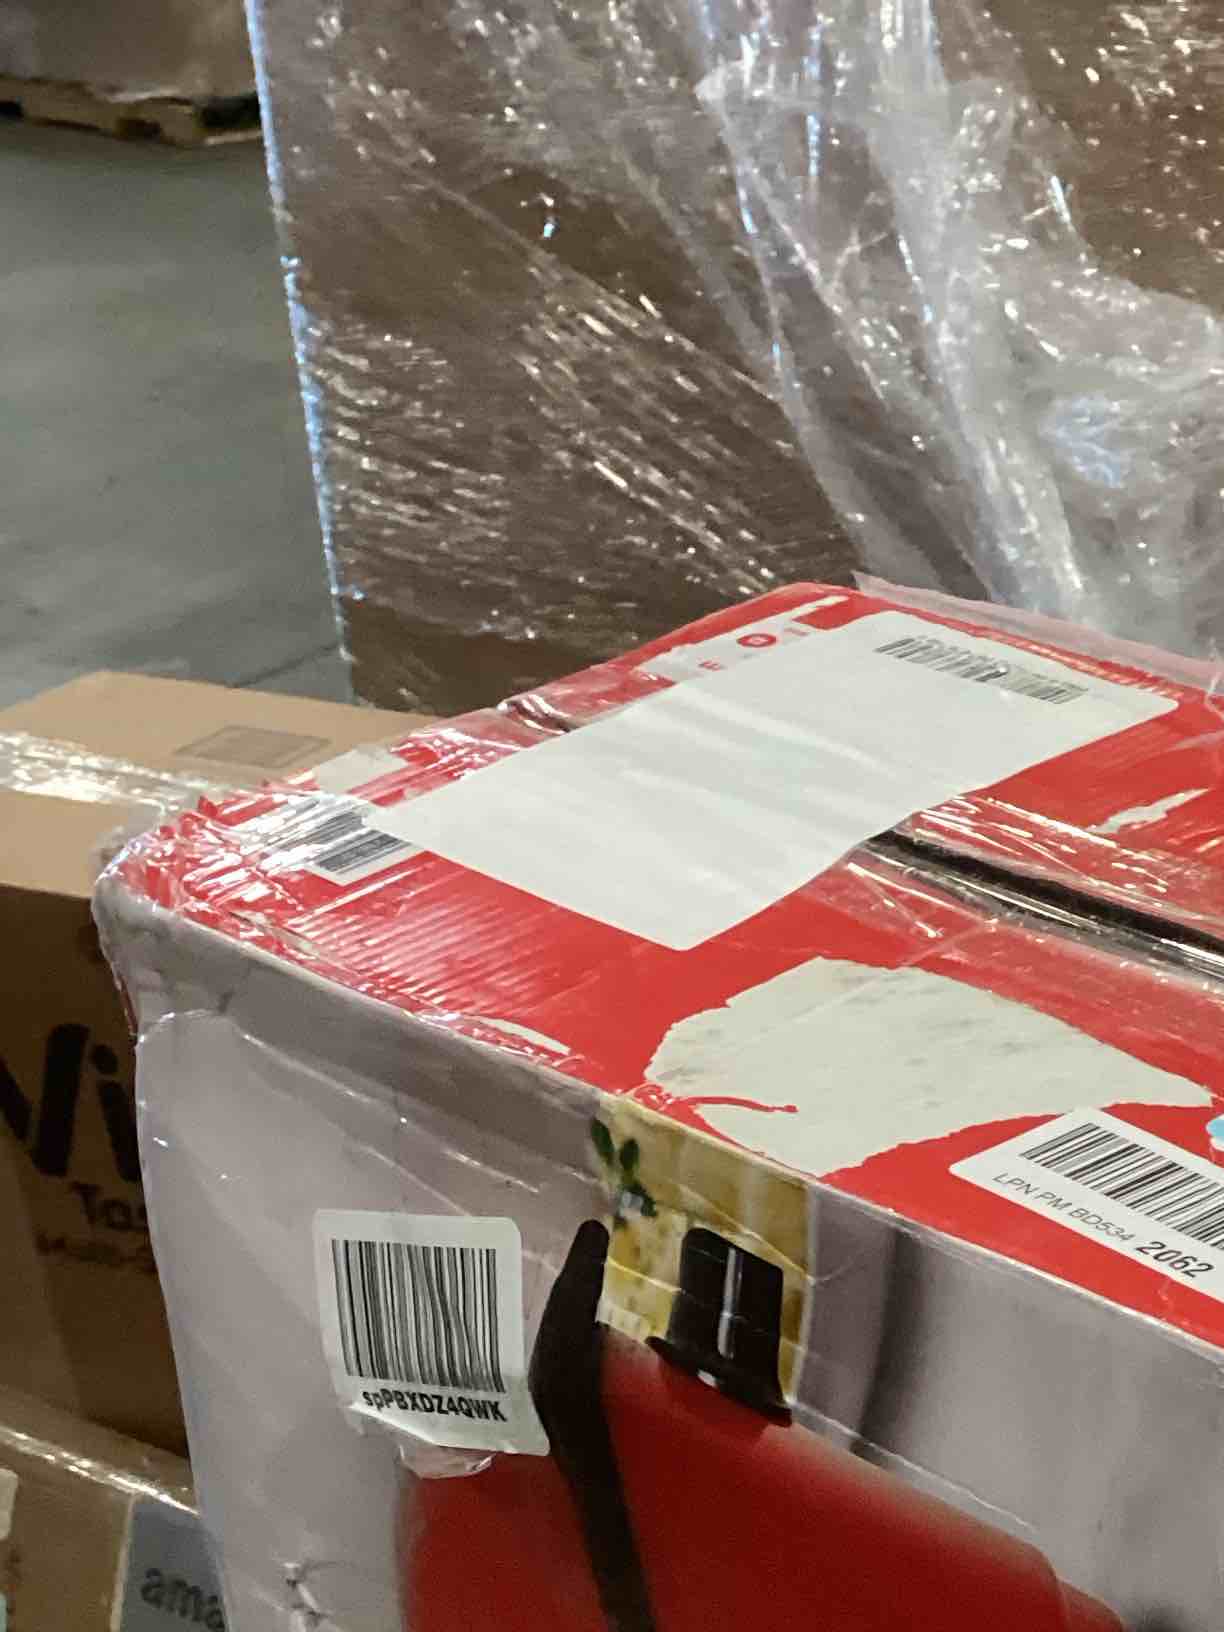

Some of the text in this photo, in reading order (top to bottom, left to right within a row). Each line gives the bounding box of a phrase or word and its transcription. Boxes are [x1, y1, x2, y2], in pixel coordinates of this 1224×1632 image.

[992, 1173, 1035, 1197] LPN
[1035, 1190, 1074, 1213] PM
[1136, 1240, 1215, 1279] 2062
